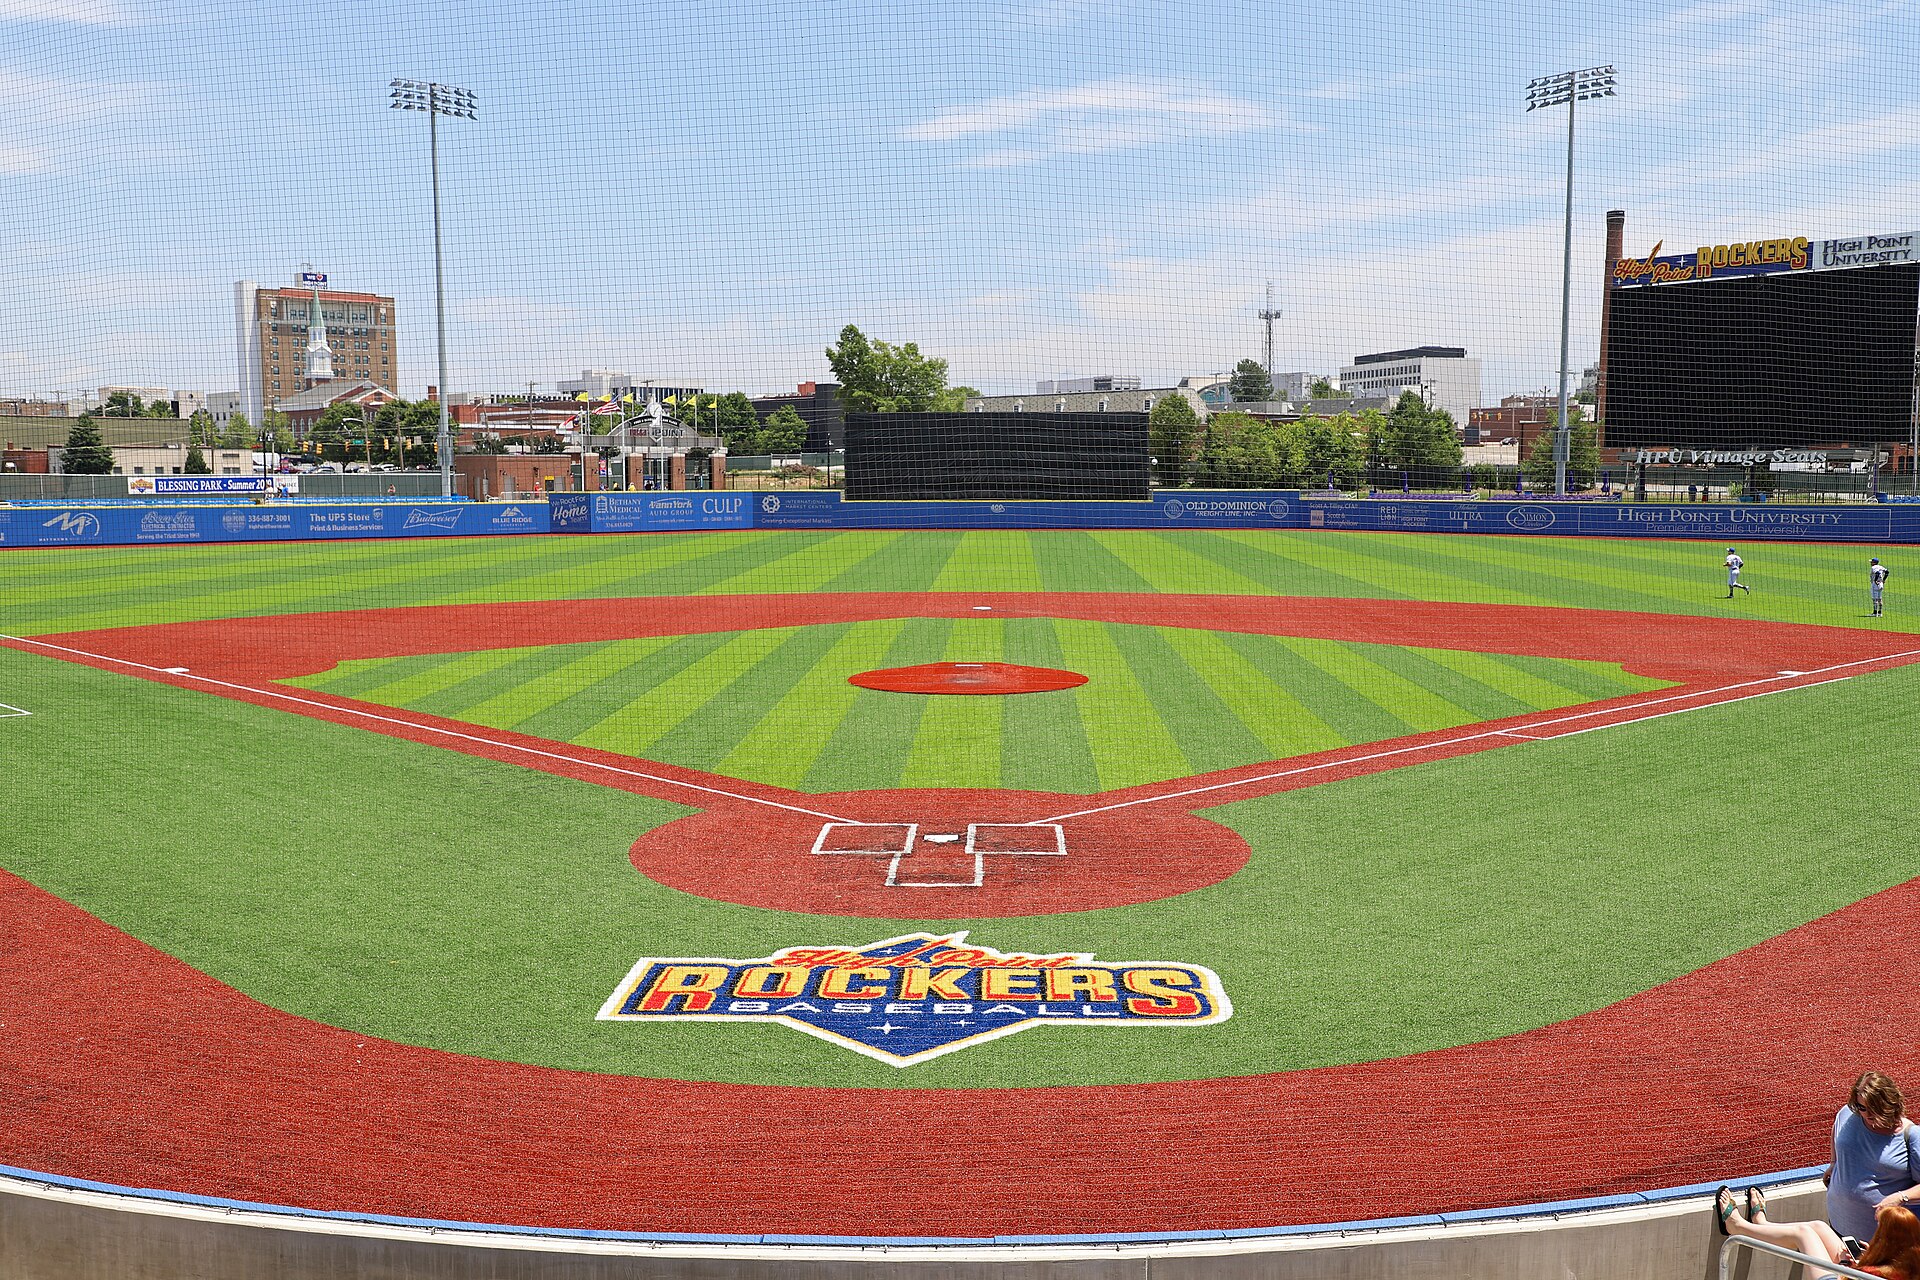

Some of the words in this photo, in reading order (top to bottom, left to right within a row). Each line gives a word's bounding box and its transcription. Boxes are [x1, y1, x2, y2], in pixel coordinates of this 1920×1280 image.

[1823, 239, 1863, 253] HIGH
[1867, 235, 1914, 250] POINT
[1613, 245, 1660, 278] High
[1651, 262, 1695, 284] Point
[1696, 237, 1808, 278] ROCKERS
[1822, 248, 1912, 267] UNIVERSITY
[1635, 450, 1683, 464] HPU
[1691, 450, 1767, 467] Vintage
[1770, 449, 1828, 463] Seats
[158, 480, 199, 491] BLESSING
[200, 479, 222, 491] PARK
[227, 480, 256, 490] Summer
[256, 479, 273, 490] 209
[609, 498, 642, 506] BETHANY
[609, 505, 642, 514] MEDICAL
[702, 498, 742, 514] CULP
[1186, 501, 1208, 510] OLD
[1211, 501, 1267, 511] DOMINION
[1380, 506, 1397, 514] RED
[309, 513, 326, 522] The
[328, 513, 346, 522] UPS
[347, 513, 370, 522] Store
[408, 512, 459, 524] Budweiser
[553, 504, 588, 521] Home
[1449, 511, 1483, 520] ULTRA
[1513, 508, 1547, 525] SIMON
[1617, 508, 1663, 522] HIGH
[1669, 508, 1723, 523] POINT
[1729, 508, 1842, 524] UNIVERSITY
[1646, 523, 1688, 533] Premier
[1690, 523, 1712, 533] Life
[1714, 523, 1744, 534] Skills
[1747, 524, 1808, 536] University
[773, 940, 948, 970] High
[932, 949, 1074, 968] Point
[636, 965, 1204, 1016] ROCKERS
[727, 1001, 1120, 1015] BASEBALL
